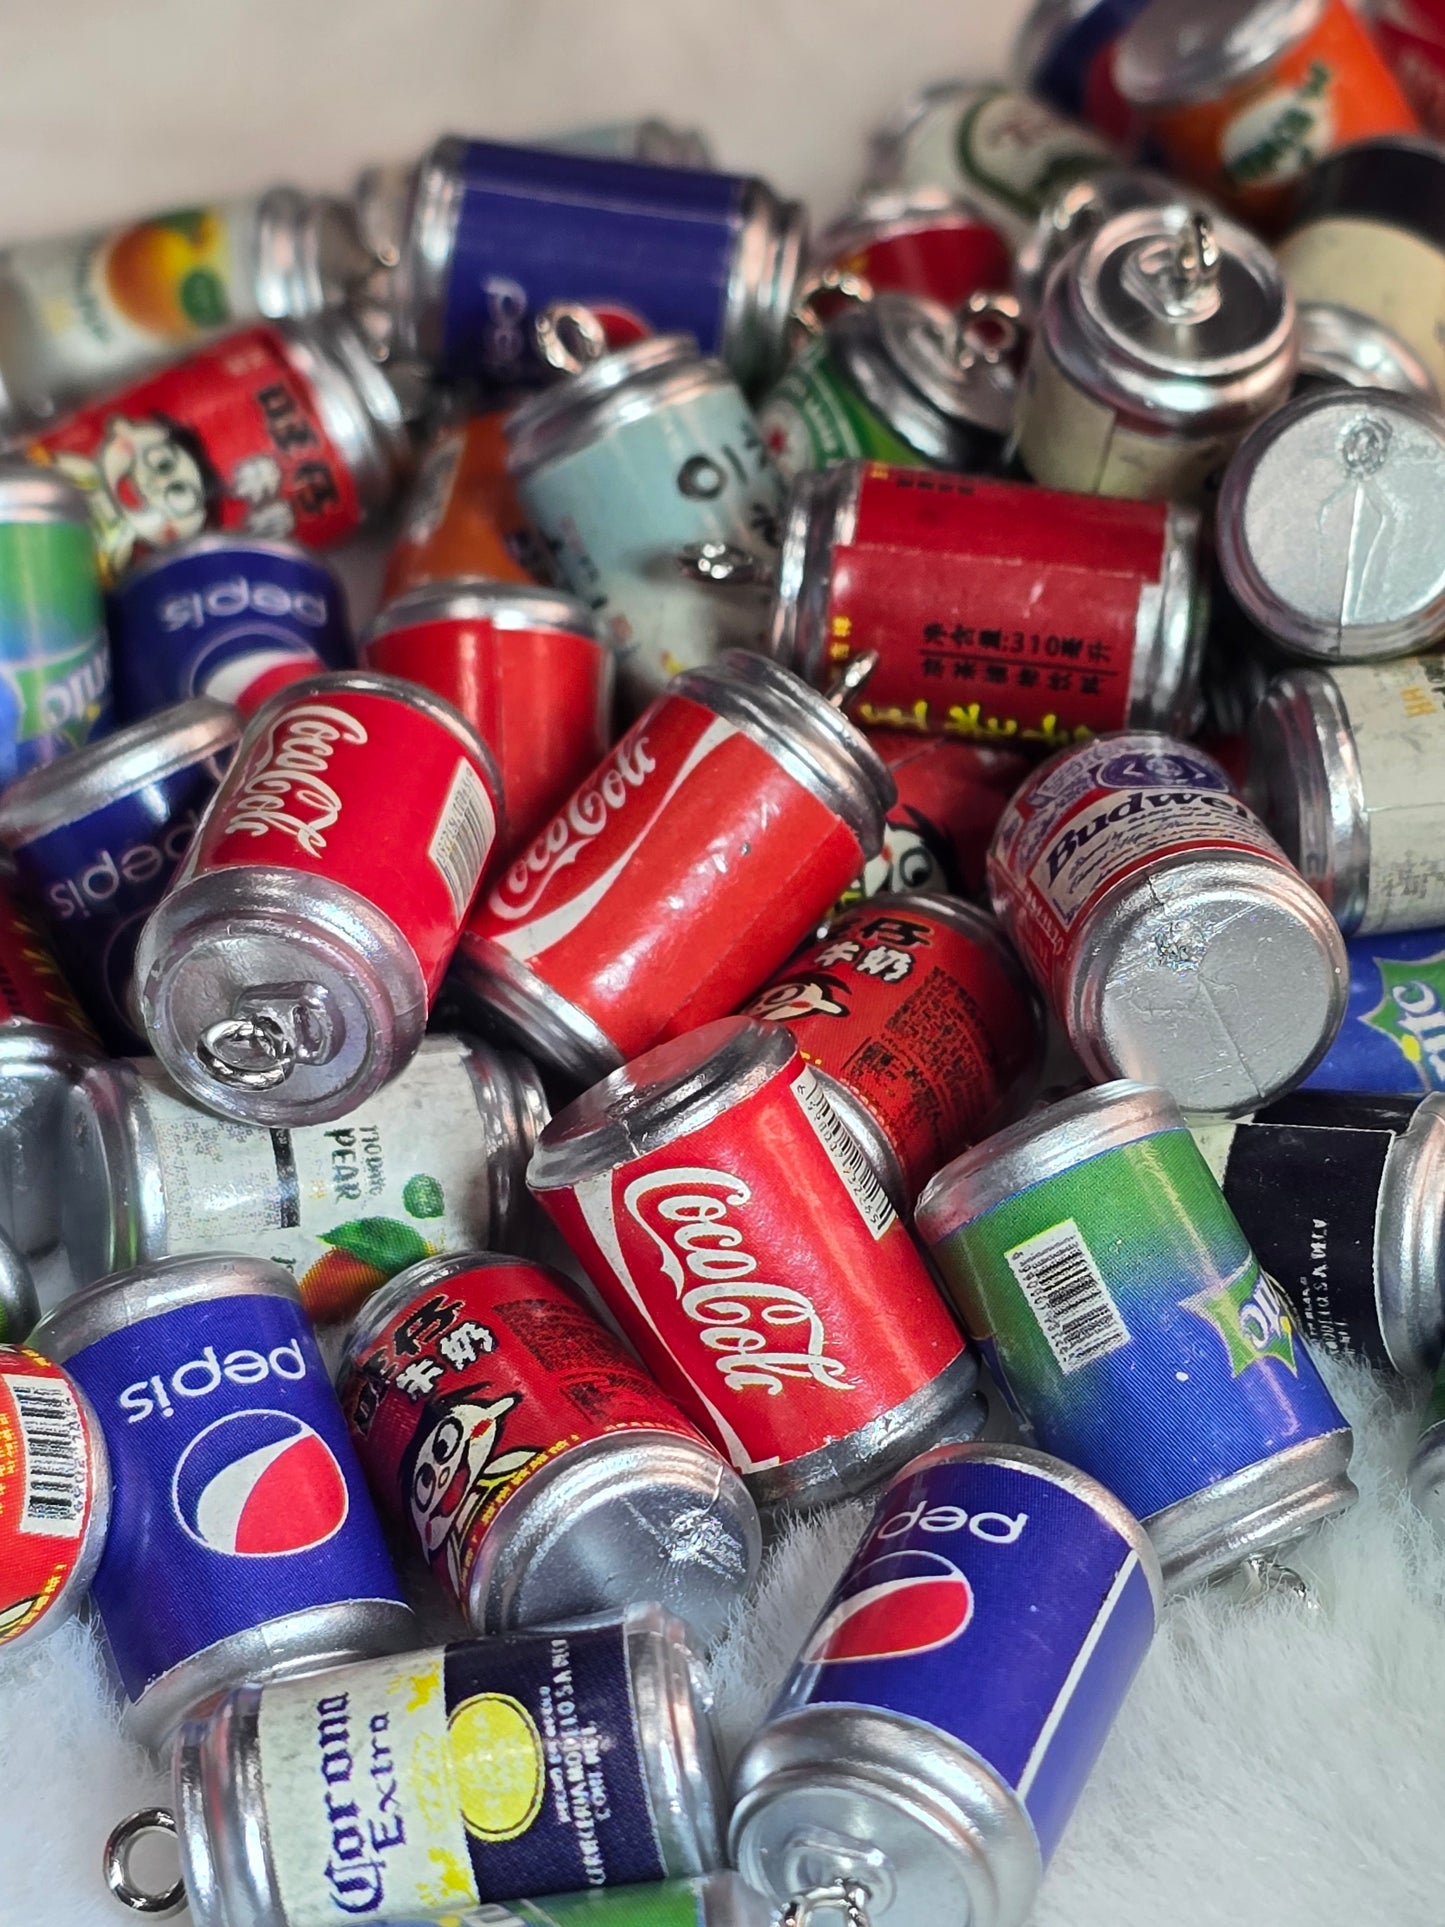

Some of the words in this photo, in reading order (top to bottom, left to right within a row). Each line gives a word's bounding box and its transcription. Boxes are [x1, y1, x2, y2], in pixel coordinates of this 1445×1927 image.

[322, 1127, 364, 1203] PEAR
[119, 1337, 307, 1425] pepis
[317, 1690, 388, 1914] Corona
[365, 1710, 408, 1853] Extra
